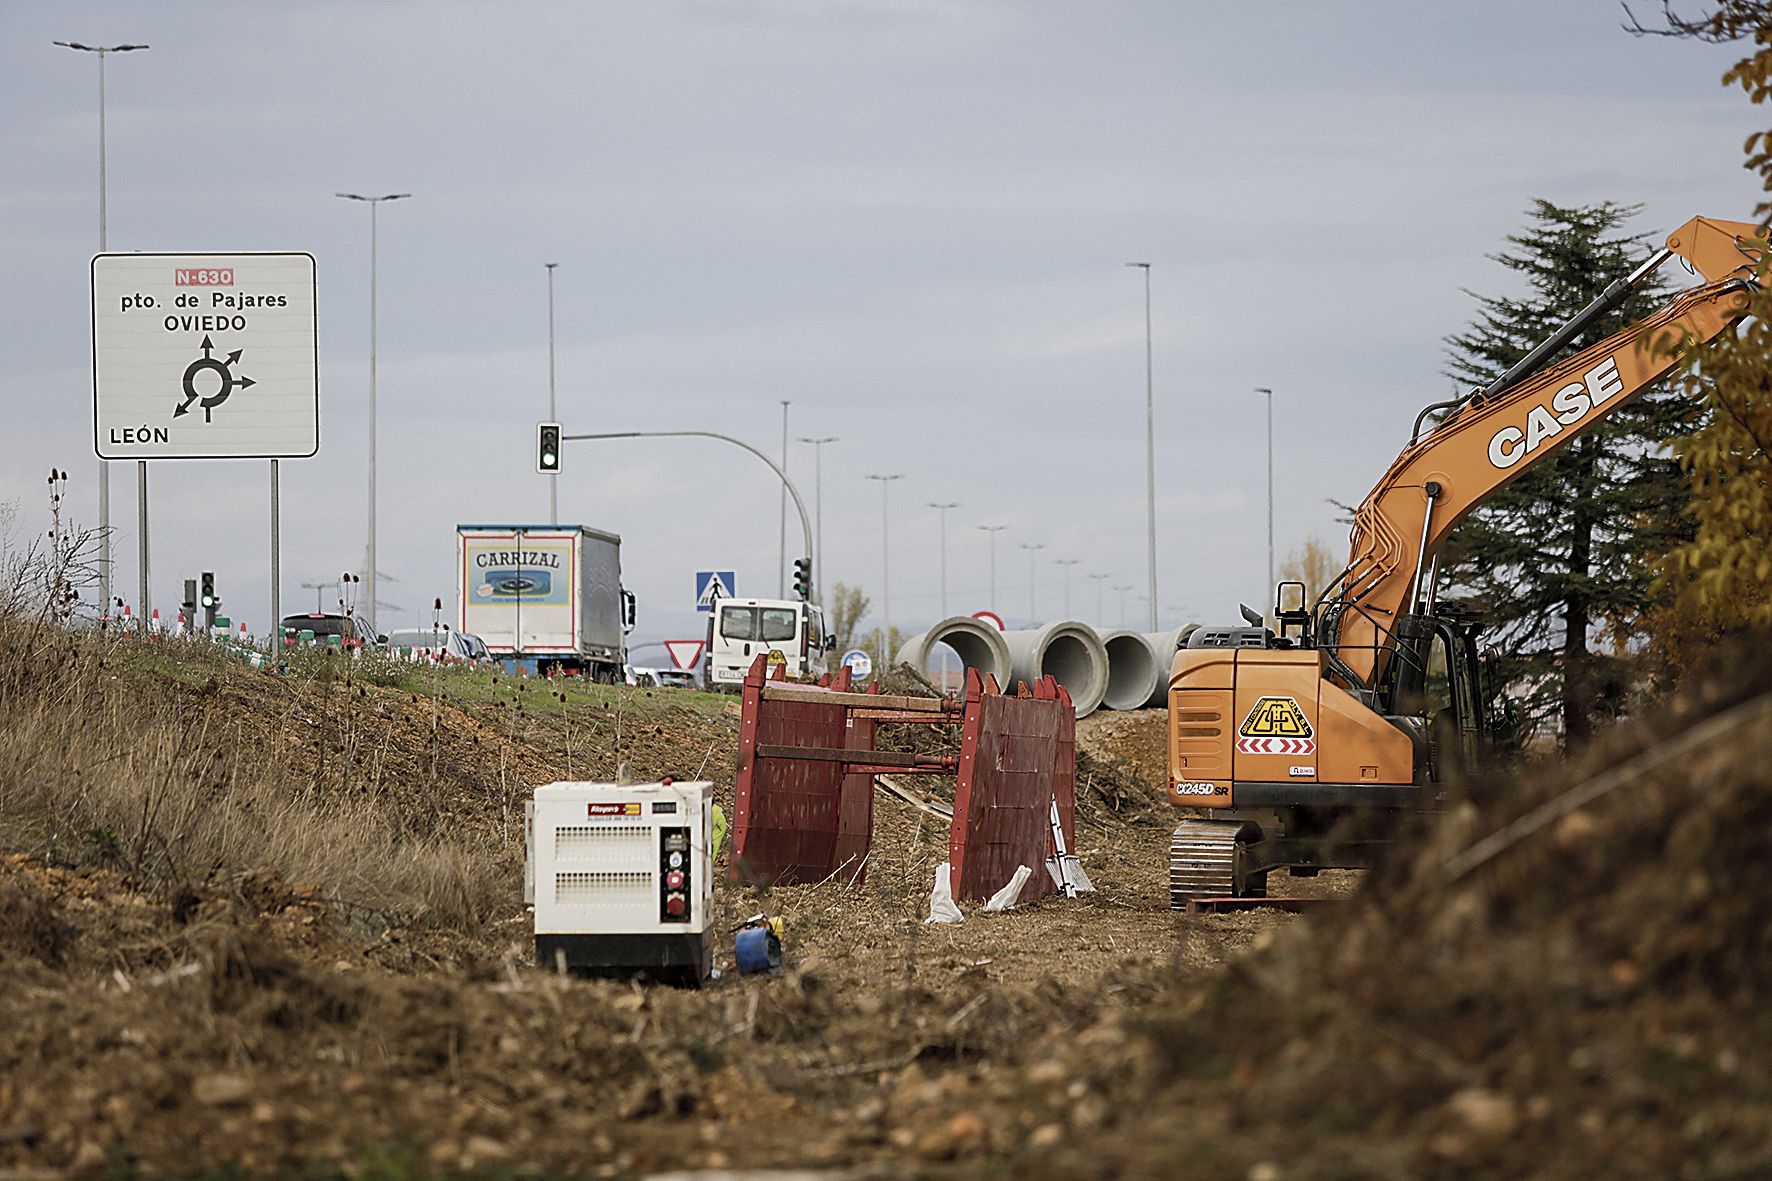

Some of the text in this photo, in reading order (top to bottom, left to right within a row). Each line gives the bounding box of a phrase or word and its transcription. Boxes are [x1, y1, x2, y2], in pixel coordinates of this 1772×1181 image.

[177, 270, 232, 285] N-630
[121, 292, 288, 312] pto. de Pajares
[164, 316, 246, 331] OVIEDO
[1488, 355, 1624, 469] CASE
[110, 425, 168, 444] LEÓN
[476, 551, 560, 568] CARRIZAL
[1214, 786, 1229, 796] SR
